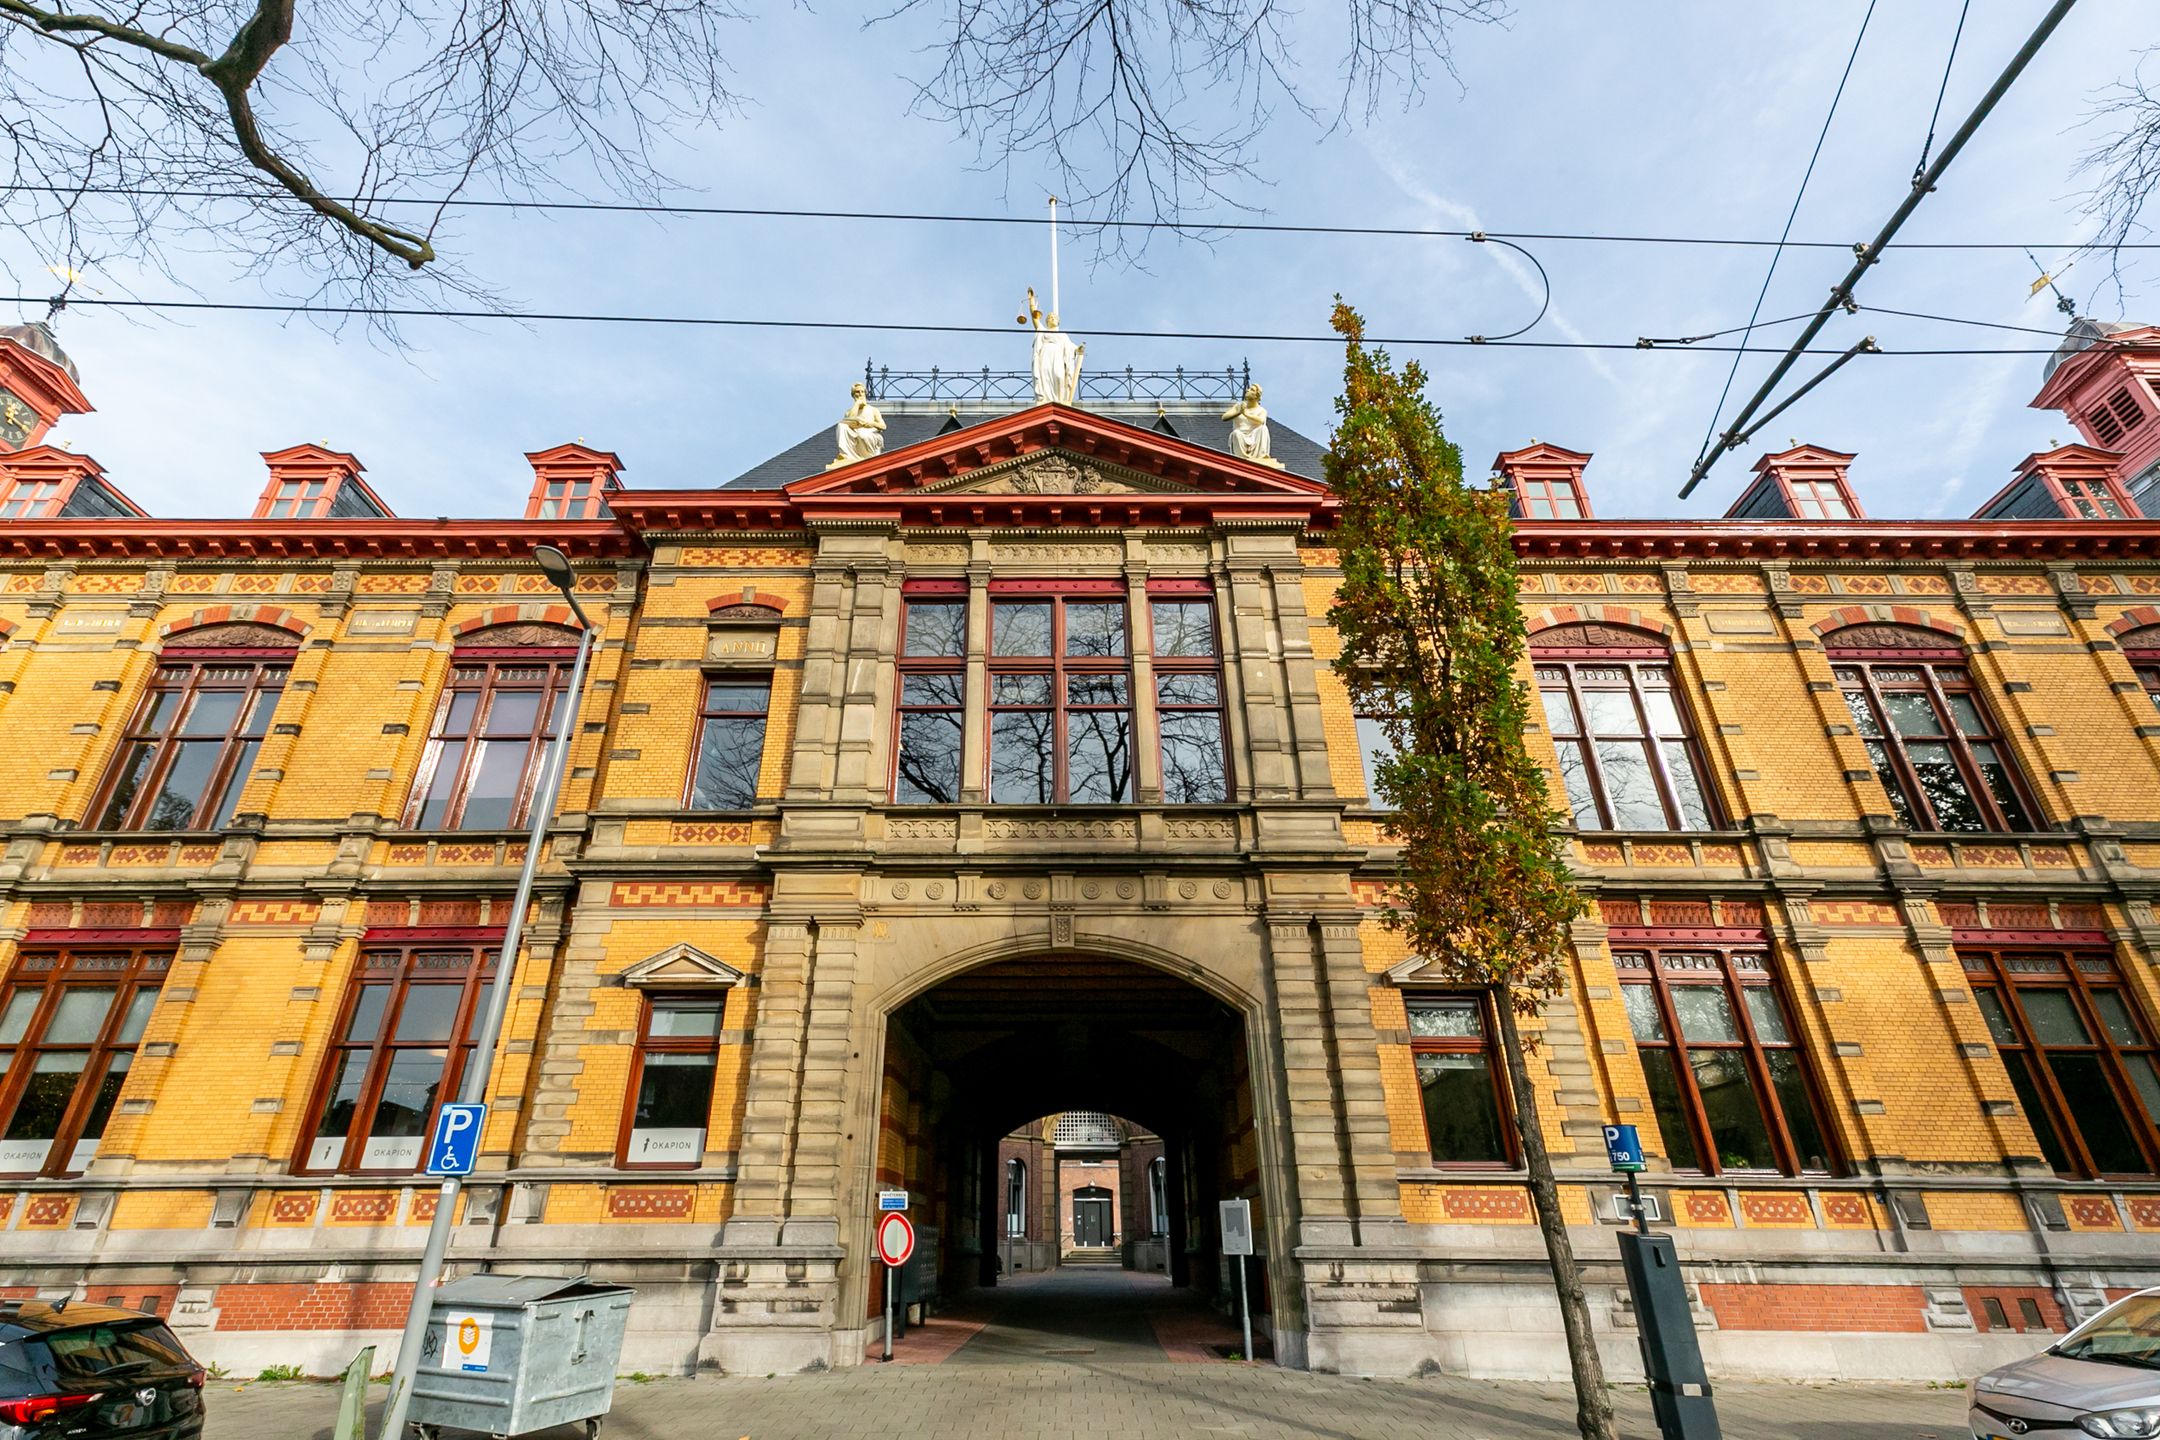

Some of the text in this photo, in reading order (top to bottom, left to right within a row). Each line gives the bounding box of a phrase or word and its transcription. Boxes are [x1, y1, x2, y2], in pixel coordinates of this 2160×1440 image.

[721, 641, 766, 654] ANNO
[443, 1109, 473, 1144] P
[1604, 1127, 1620, 1149] P
[652, 1141, 691, 1150] OKAPION
[4, 1151, 43, 1160] OKAPION
[374, 1149, 412, 1157] OKAPION
